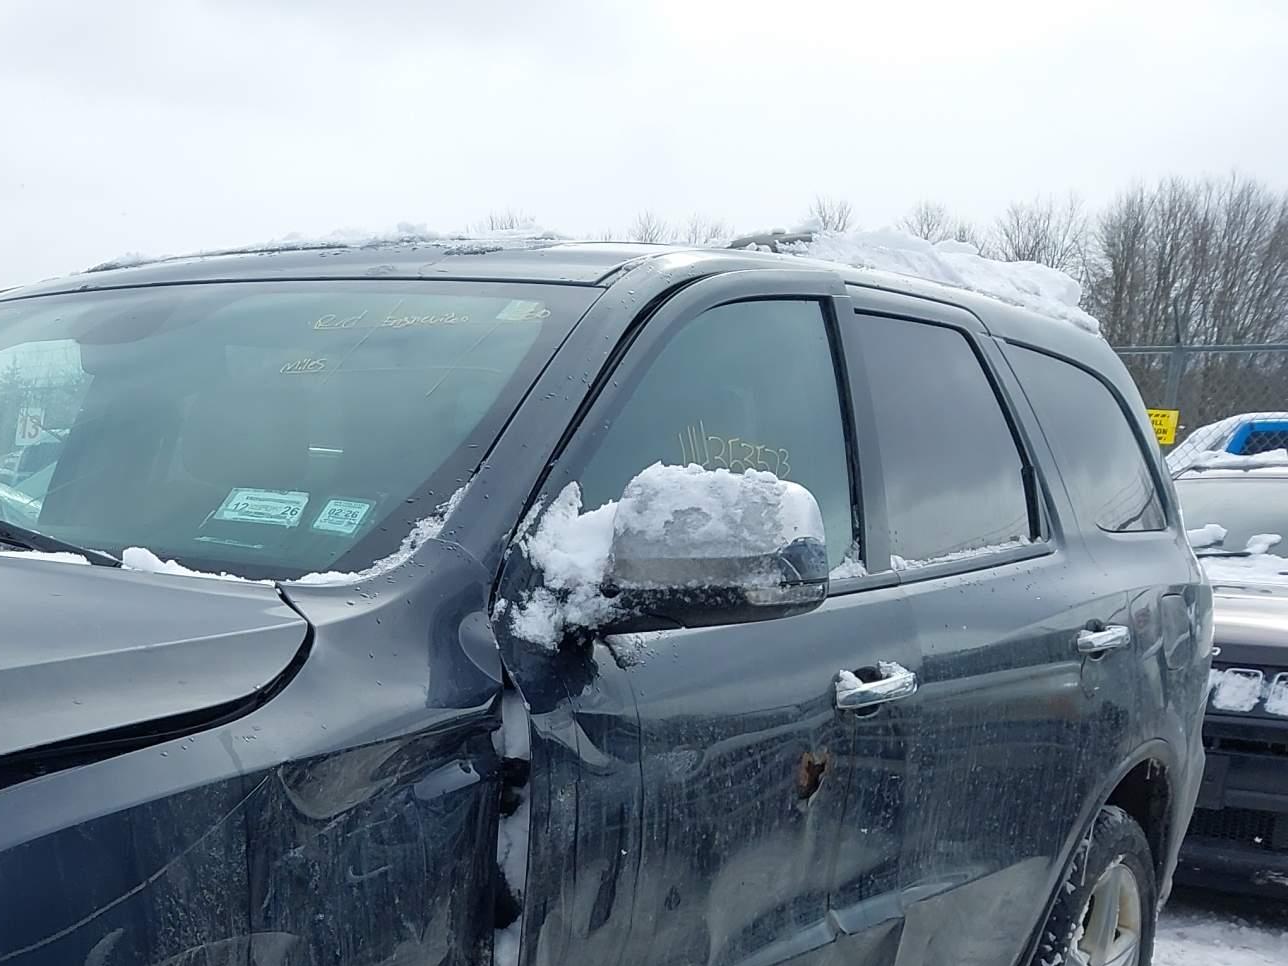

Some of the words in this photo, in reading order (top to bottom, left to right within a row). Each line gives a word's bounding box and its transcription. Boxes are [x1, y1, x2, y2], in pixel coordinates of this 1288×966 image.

[20, 415, 41, 439] 13
[232, 501, 250, 512] 12
[280, 505, 301, 516] 26
